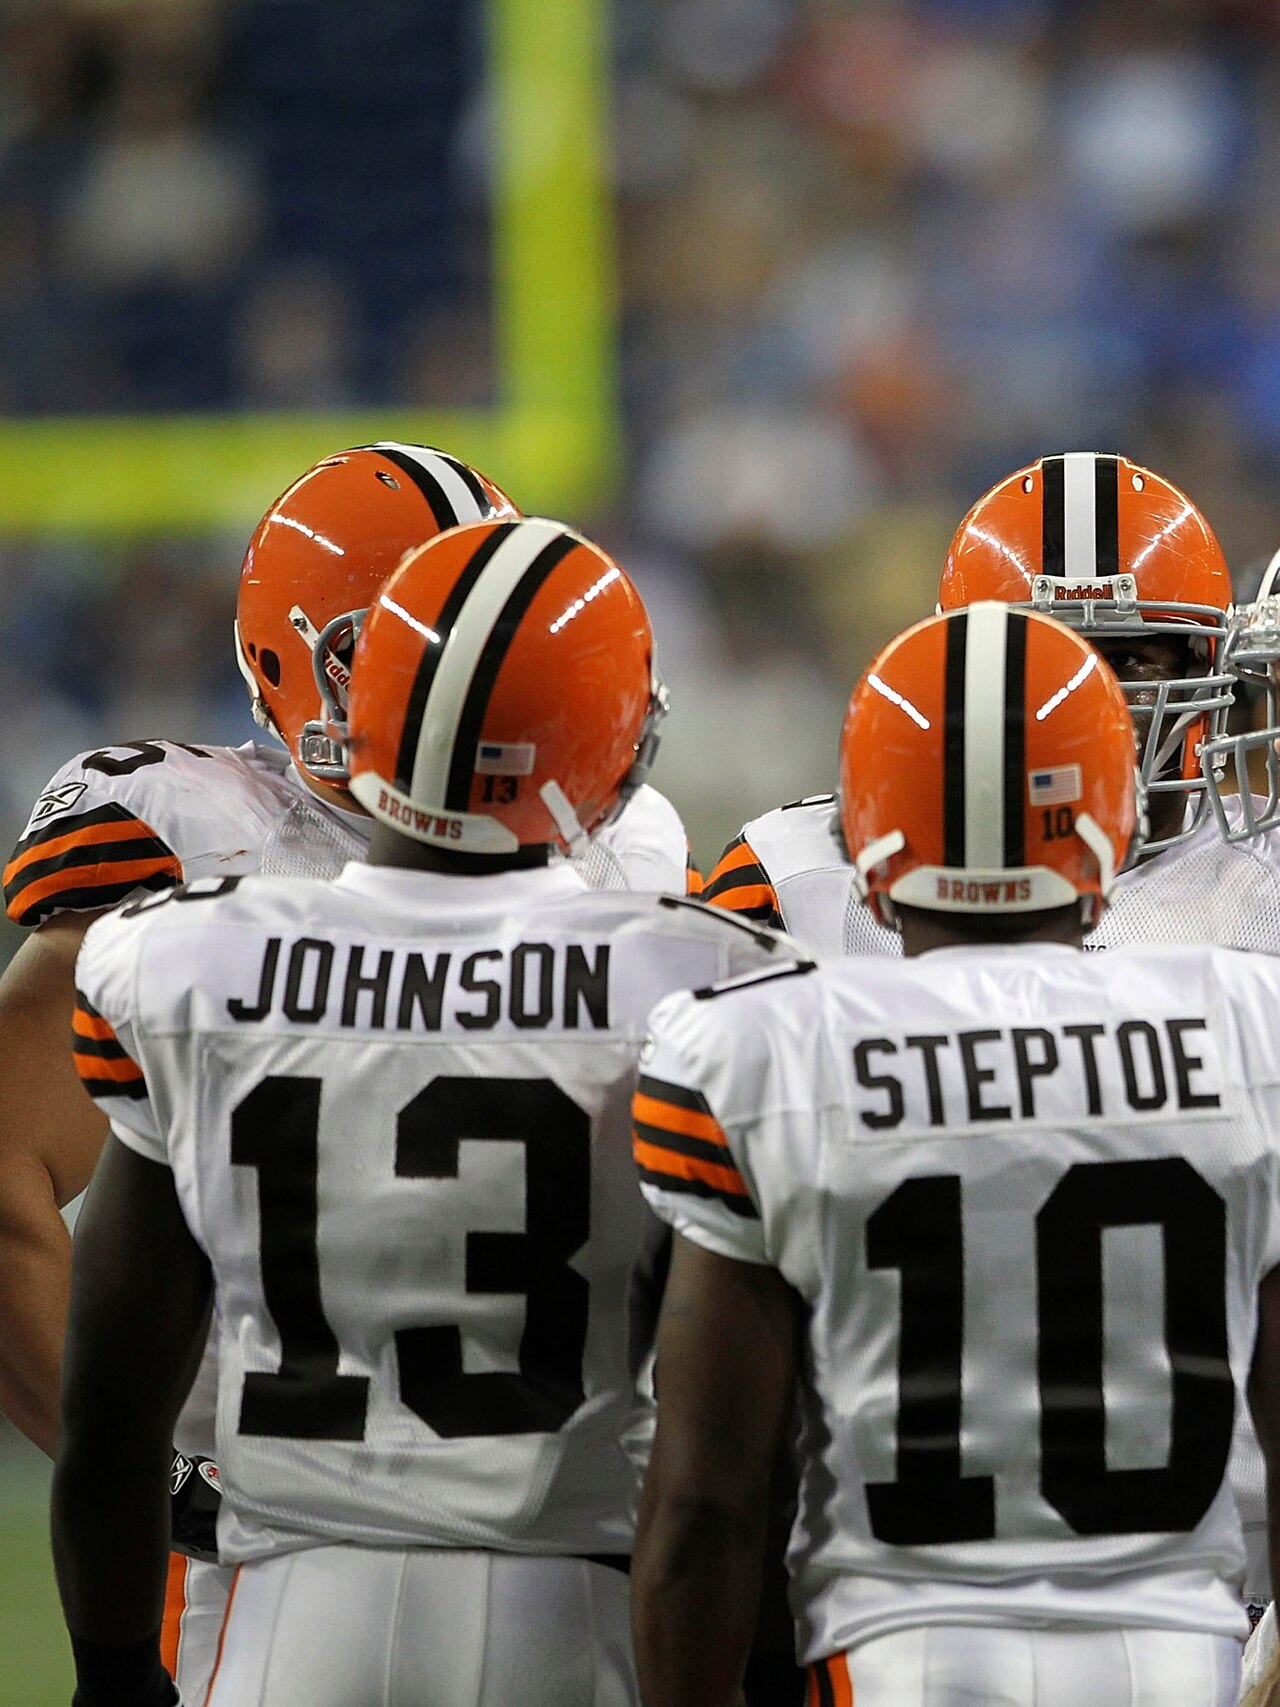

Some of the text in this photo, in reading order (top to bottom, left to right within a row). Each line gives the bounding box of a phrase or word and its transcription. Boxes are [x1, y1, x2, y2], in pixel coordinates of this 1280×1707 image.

[1055, 584, 1114, 600] Riddell
[378, 789, 464, 840] BROWNS
[482, 775, 518, 804] 13
[1043, 806, 1075, 842] 10
[937, 877, 1032, 904] BROWNS
[227, 937, 611, 1032] JOHNSON
[853, 1018, 1221, 1131] STEPTOE
[230, 1075, 591, 1442] 13
[865, 1156, 1235, 1546] 10
